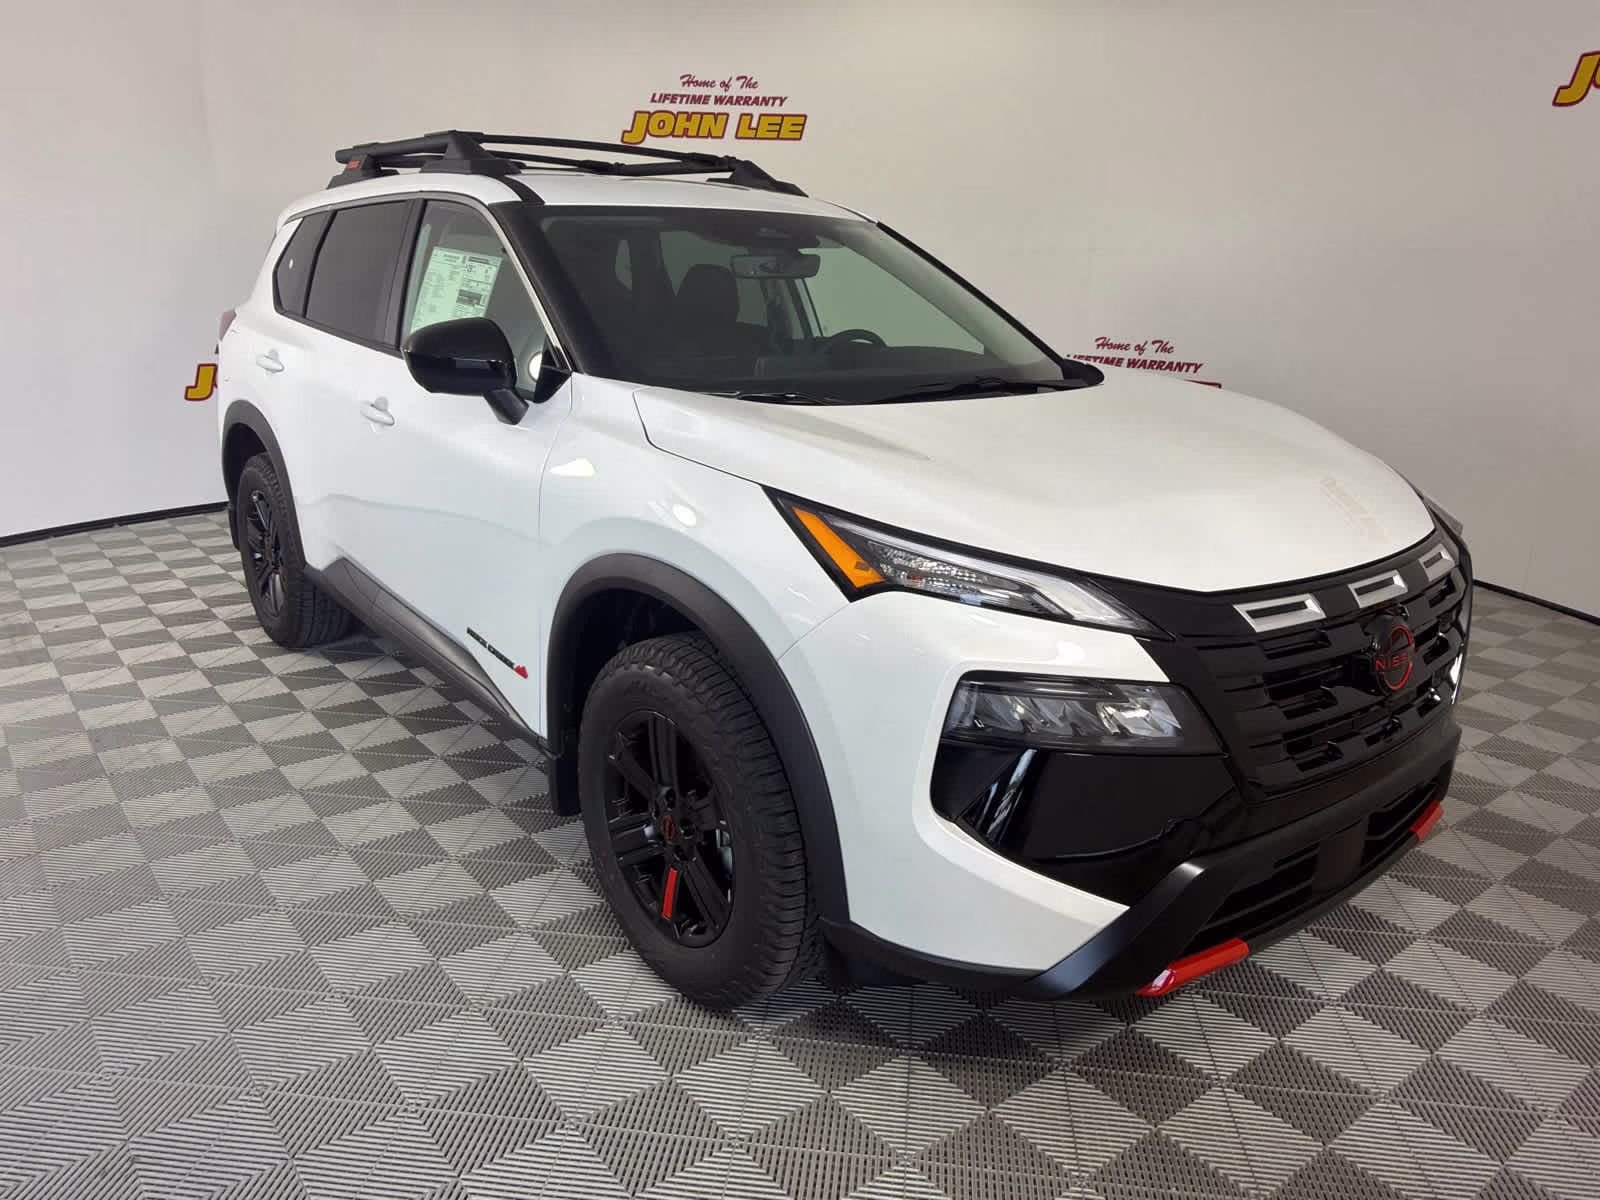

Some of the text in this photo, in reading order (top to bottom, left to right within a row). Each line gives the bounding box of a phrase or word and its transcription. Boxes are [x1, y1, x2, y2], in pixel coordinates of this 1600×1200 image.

[680, 74, 759, 91] Home of The
[650, 93, 787, 107] LIFETIME WARRANTY
[621, 110, 808, 145] JOHN LEE
[1095, 336, 1174, 355] Home of The
[1126, 358, 1203, 374] WARRANTY
